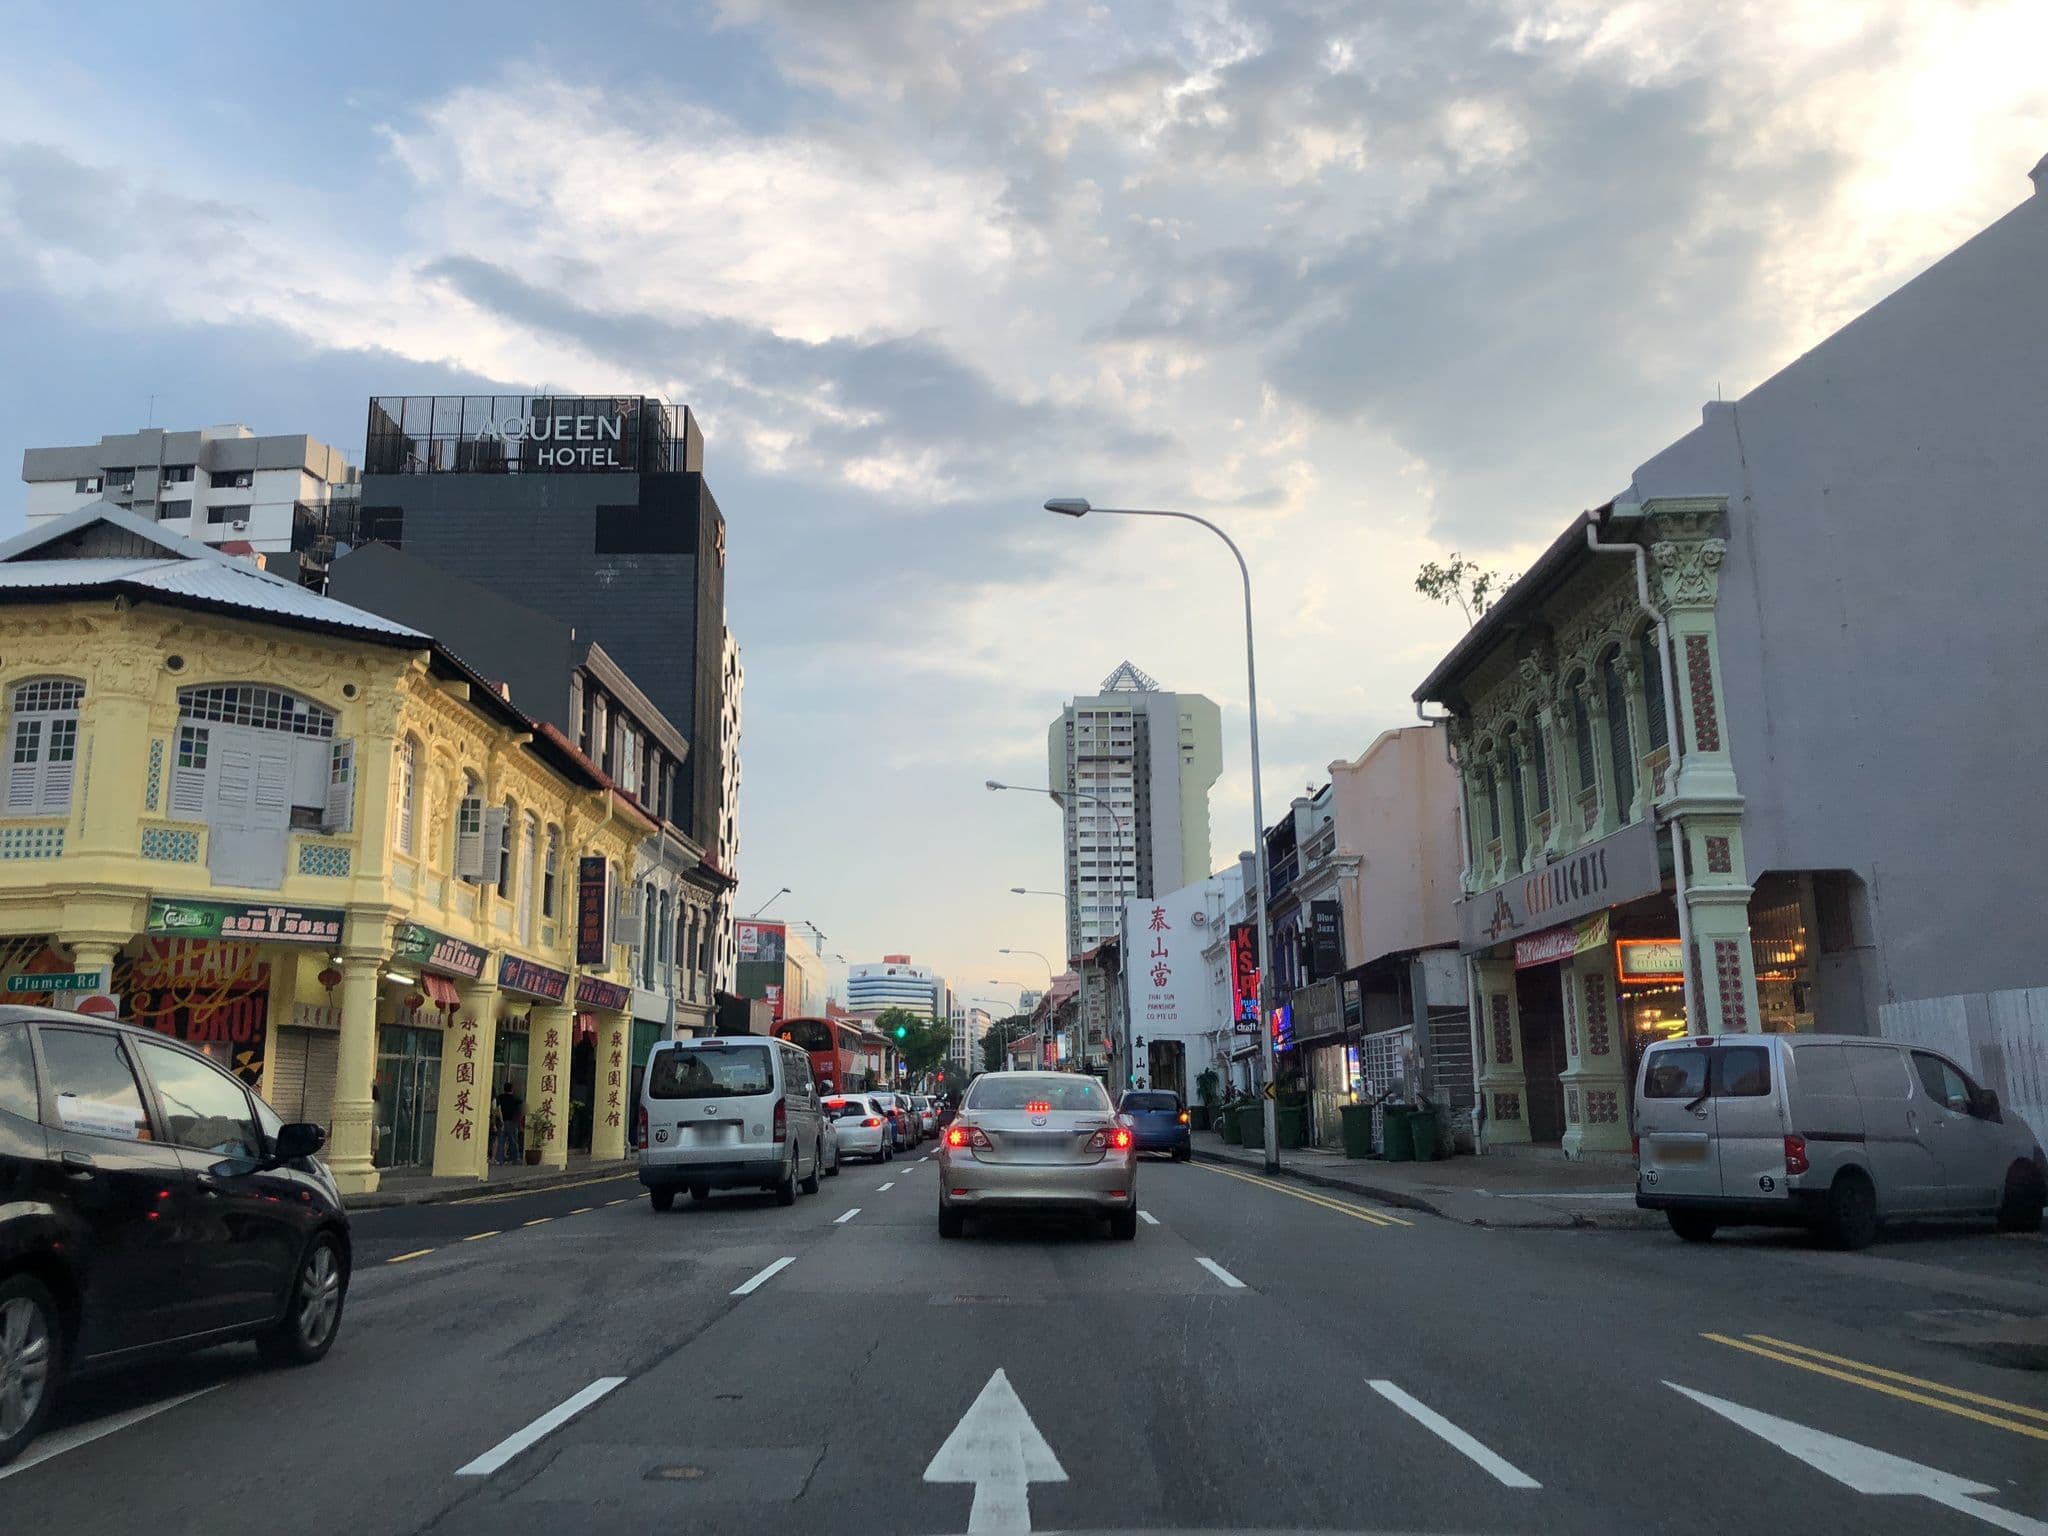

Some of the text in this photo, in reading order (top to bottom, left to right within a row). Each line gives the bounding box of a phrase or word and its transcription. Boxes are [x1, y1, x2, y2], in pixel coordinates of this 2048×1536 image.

[475, 416, 622, 444] AQUEEN
[538, 448, 619, 466] HOTEL
[164, 911, 202, 926] Carlsberg
[15, 975, 96, 990] Plumer Rd
[657, 1131, 667, 1140] 70
[1647, 1173, 1658, 1182] 70
[1763, 1177, 1770, 1186] 5
